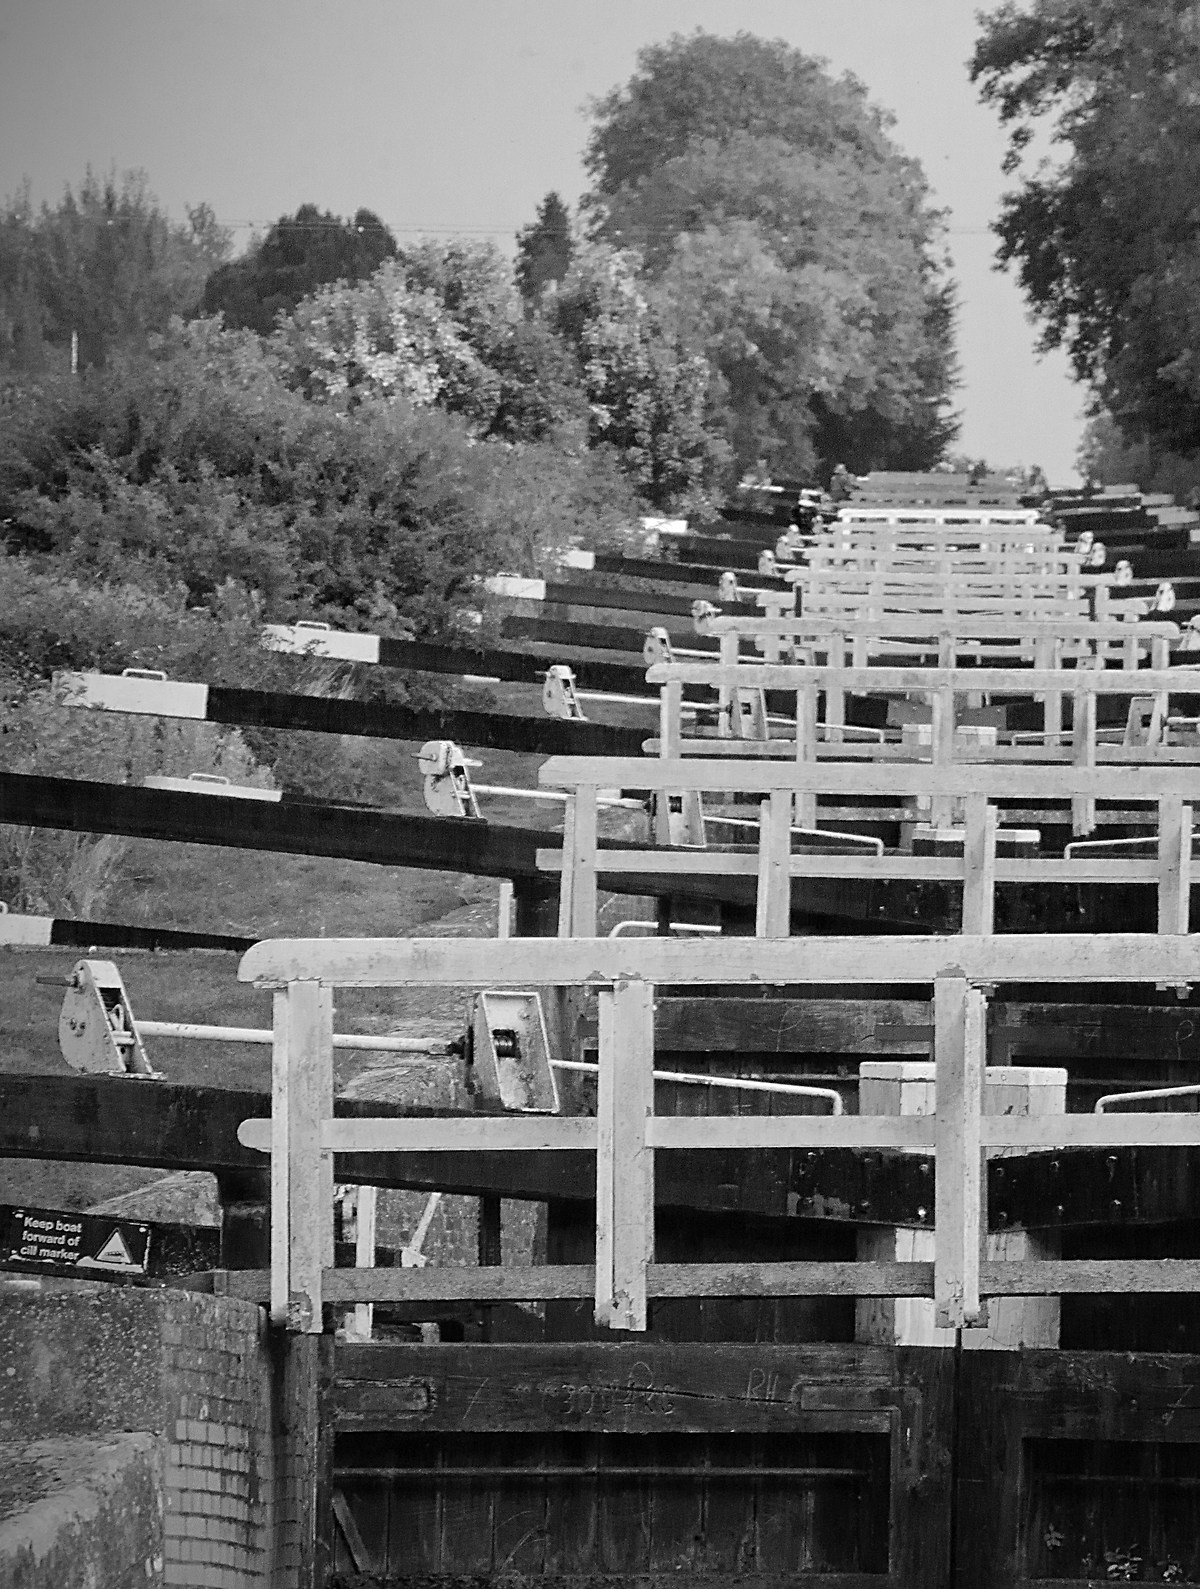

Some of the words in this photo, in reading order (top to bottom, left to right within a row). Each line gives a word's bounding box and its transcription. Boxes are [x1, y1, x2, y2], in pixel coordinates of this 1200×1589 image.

[23, 1216, 54, 1231] Keep
[55, 1220, 82, 1233] boat
[22, 1230, 66, 1245] forward
[67, 1236, 81, 1247] of
[20, 1245, 38, 1256] cill
[38, 1249, 80, 1260] marker
